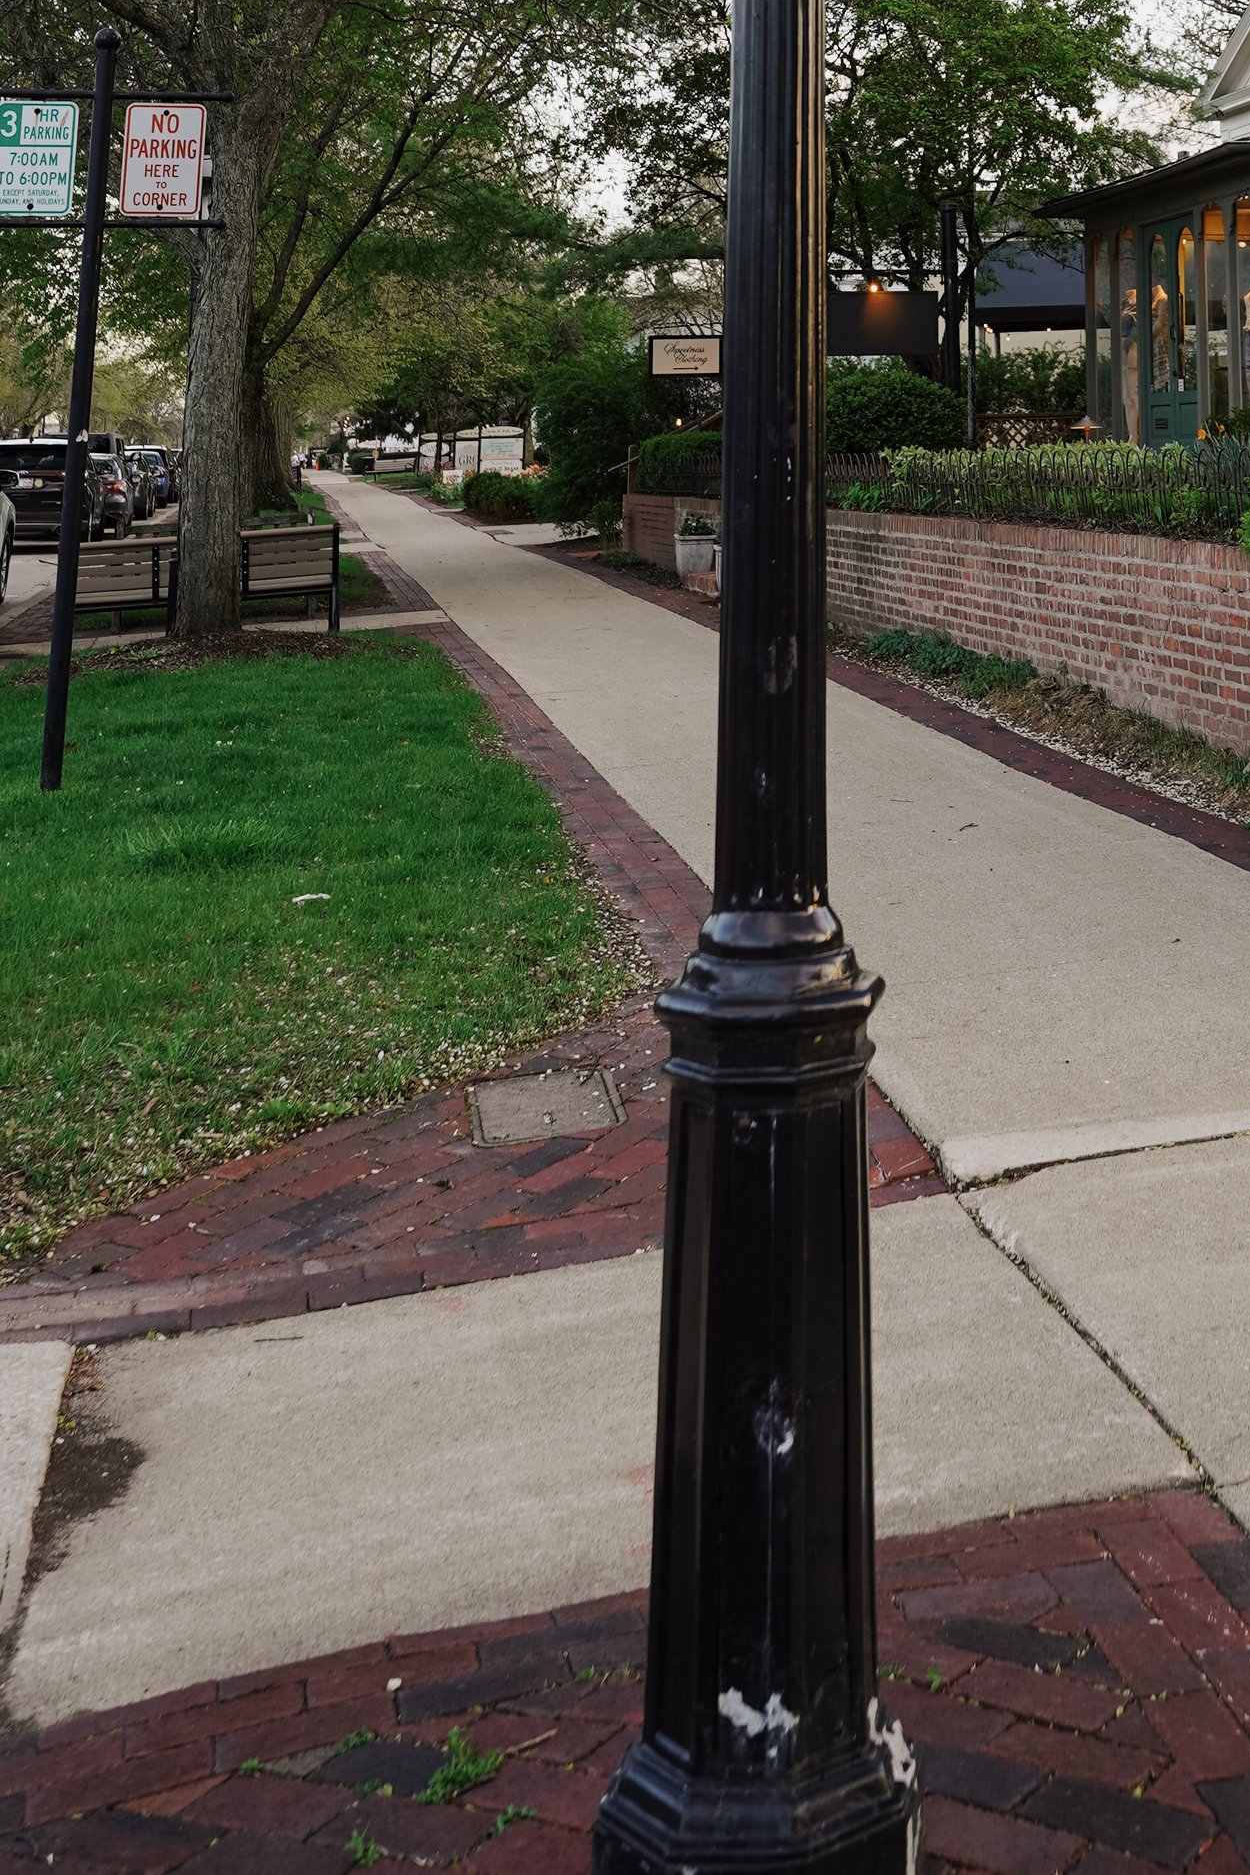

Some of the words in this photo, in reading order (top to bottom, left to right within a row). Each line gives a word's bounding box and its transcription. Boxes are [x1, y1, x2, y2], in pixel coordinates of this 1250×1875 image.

[1, 110, 17, 137] 3
[40, 109, 60, 123] HR
[151, 114, 180, 134] NO
[23, 126, 69, 140] PARKING
[129, 138, 198, 160] PARKING
[10, 152, 58, 166] 7:00AM
[144, 164, 180, 178] HERE
[19, 172, 67, 185] 6:00PM
[155, 181, 168, 189] TO
[3, 189, 25, 197] EXCEPT
[133, 192, 188, 207] CORNER
[0, 198, 21, 206] UNDAY,
[664, 341, 705, 356] Sweetness
[675, 353, 708, 366] Clothing
